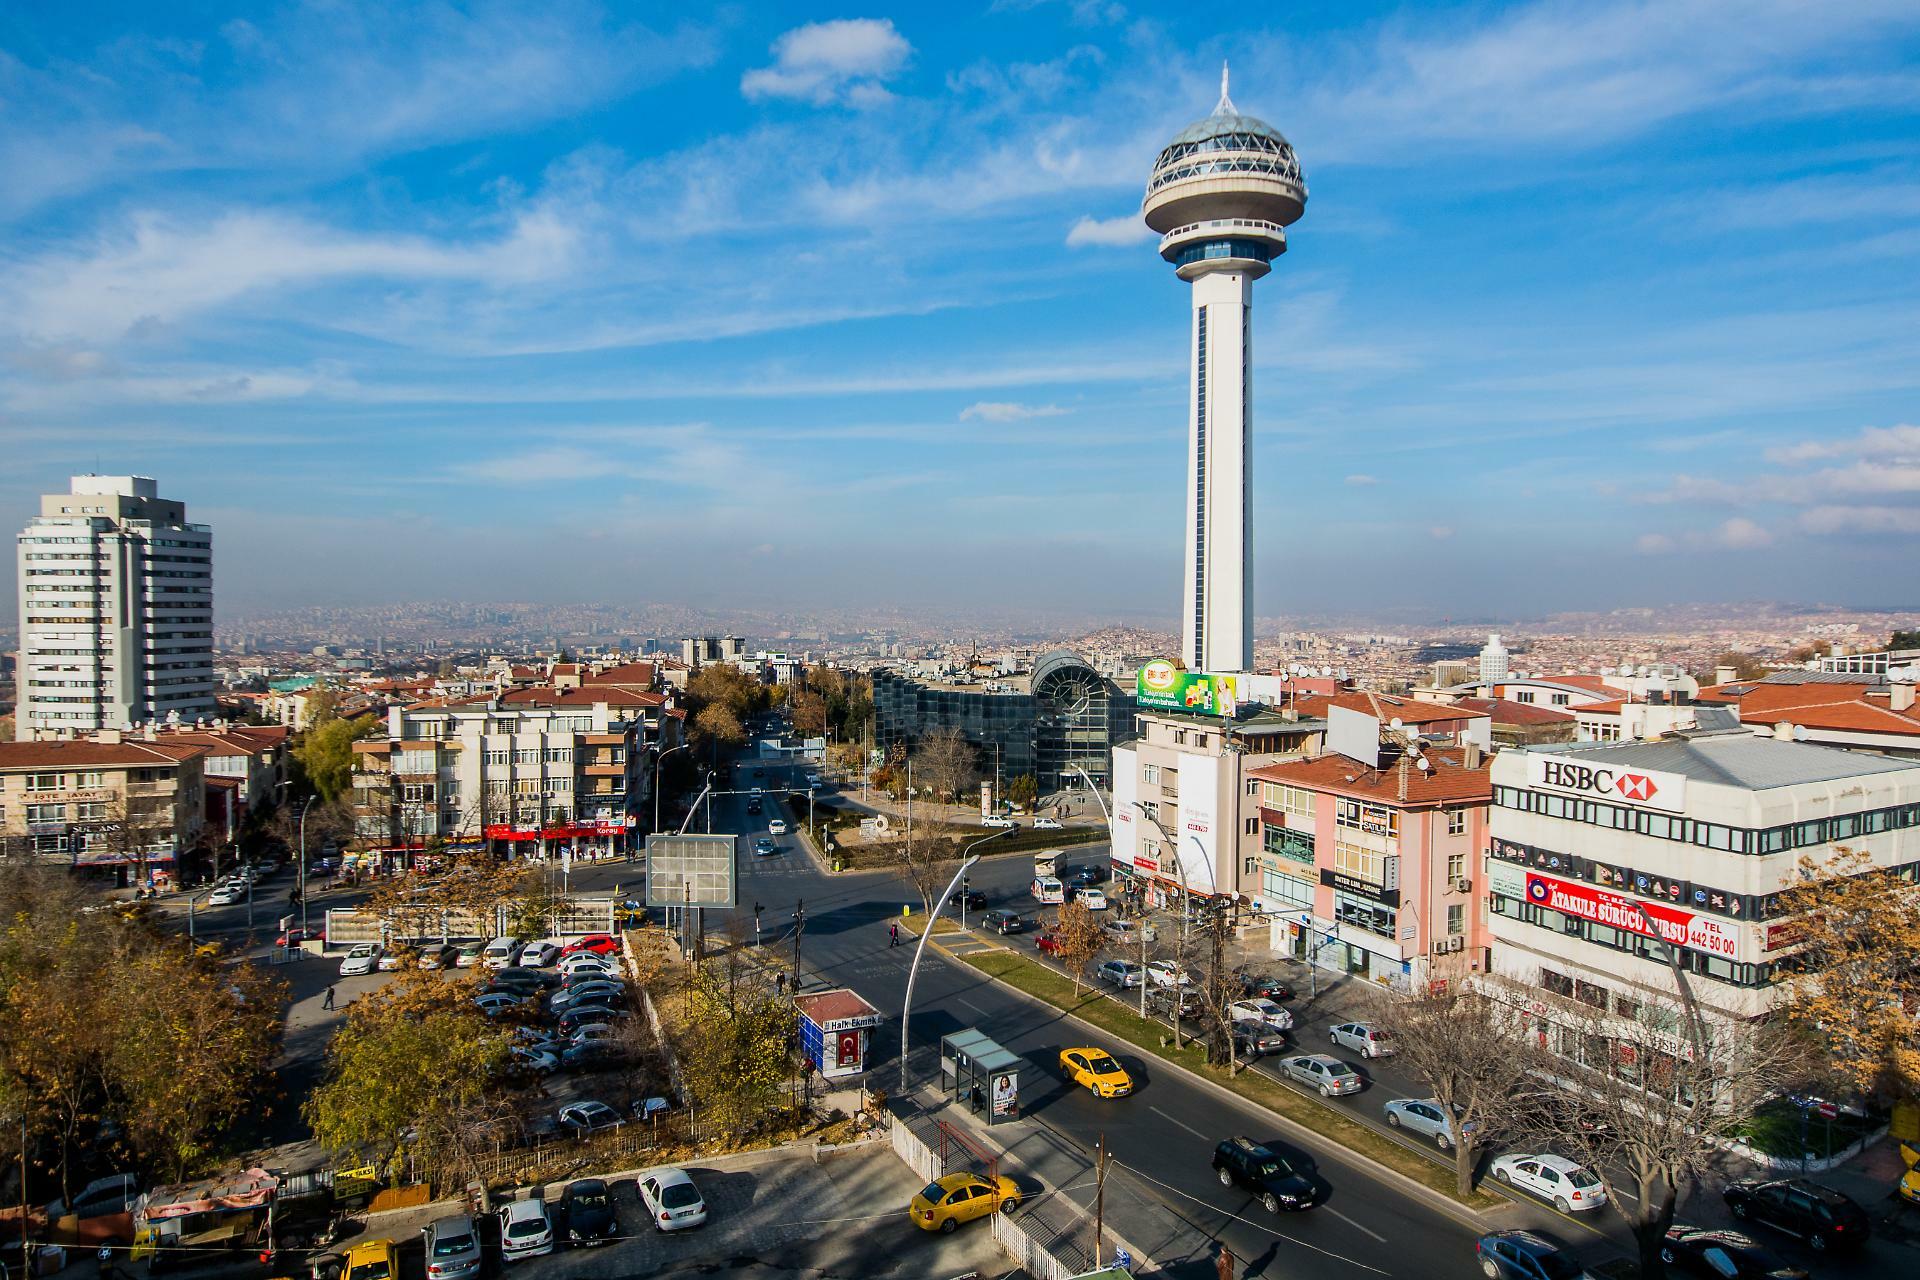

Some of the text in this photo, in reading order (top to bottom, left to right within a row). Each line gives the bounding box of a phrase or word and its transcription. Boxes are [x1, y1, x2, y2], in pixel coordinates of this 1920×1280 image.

[1543, 760, 1613, 794] HSBC
[596, 827, 618, 835] Koray
[1334, 875, 1351, 886] INTER
[1550, 890, 1597, 918] ATAKULE
[1703, 921, 1723, 934] TEL
[1690, 931, 1735, 956] 442 50 00
[832, 1020, 849, 1031] Halk
[851, 1016, 877, 1028] Ekmek
